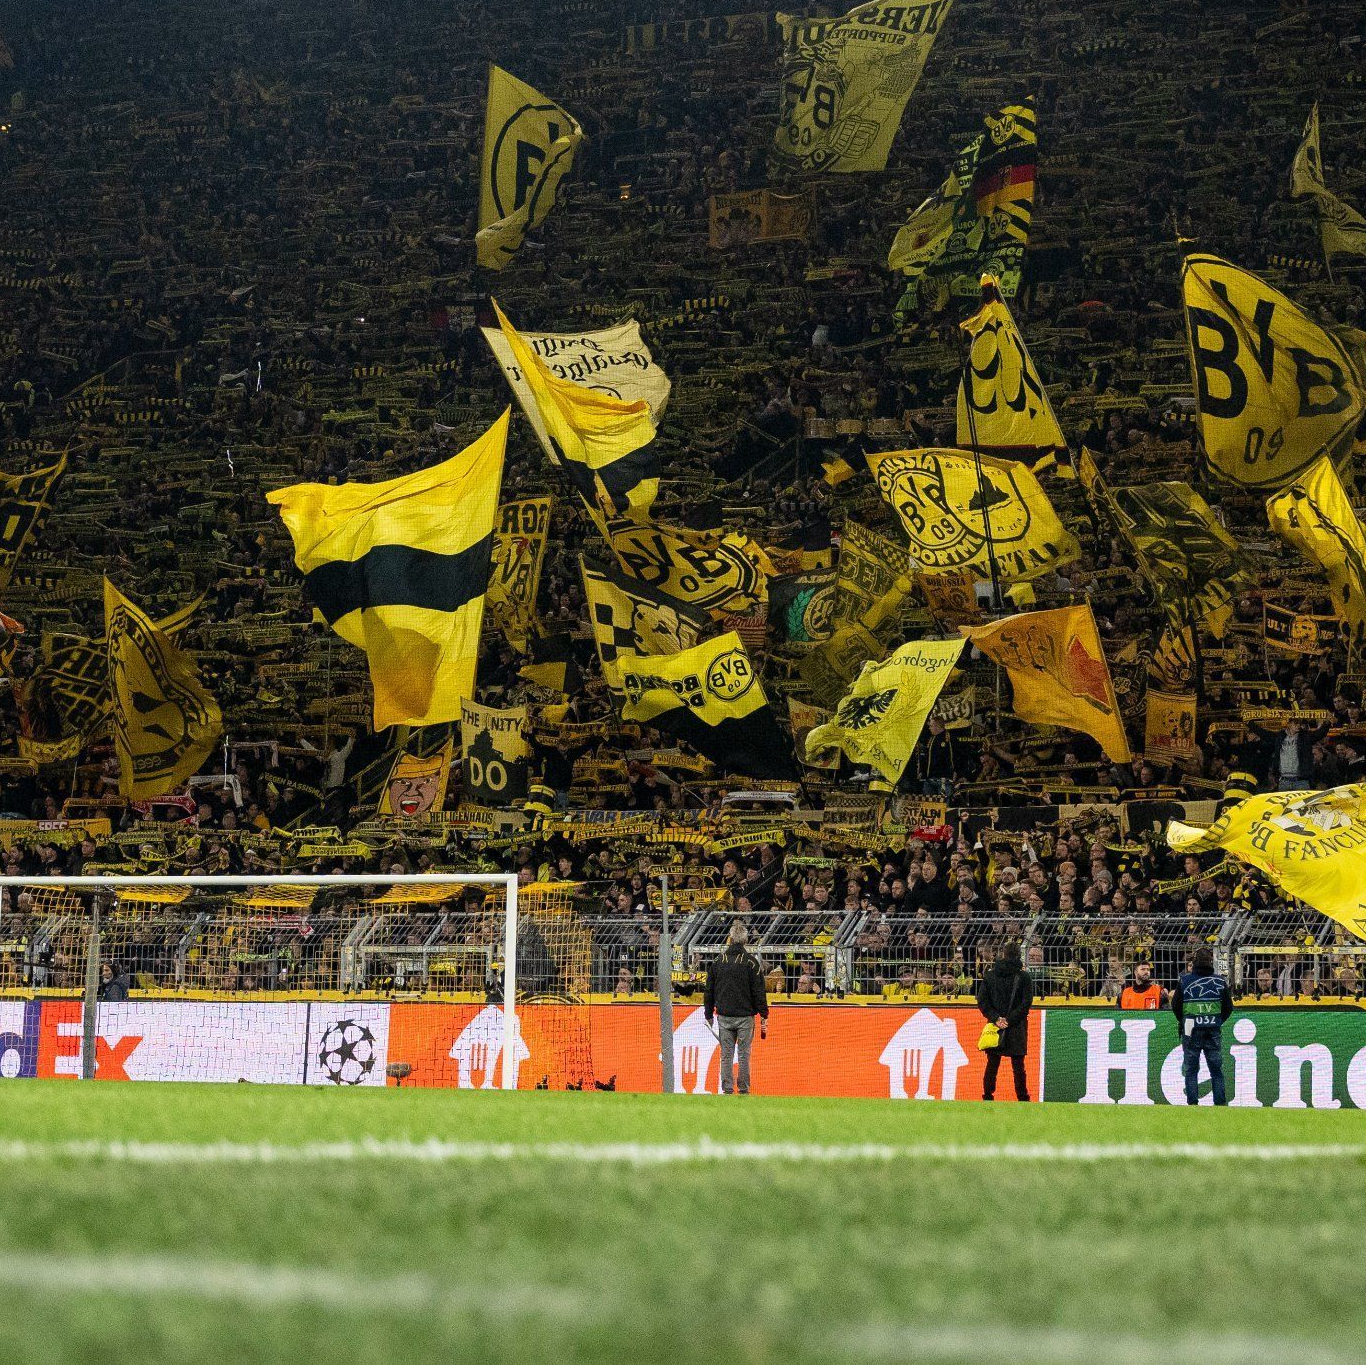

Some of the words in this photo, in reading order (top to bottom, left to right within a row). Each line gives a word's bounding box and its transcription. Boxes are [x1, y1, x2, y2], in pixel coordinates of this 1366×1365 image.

[1186, 278, 1352, 419] BVB
[1243, 426, 1285, 465] 09
[931, 516, 954, 542] 09
[908, 534, 985, 567] DORTM
[462, 709, 480, 727] THE
[487, 714, 524, 733] NITY
[470, 755, 508, 792] DO
[430, 811, 494, 824] HEILIGENHAUS
[901, 818, 936, 826] TADION
[1160, 877, 1191, 890] BORUSSIA
[1196, 1003, 1213, 1014] TV
